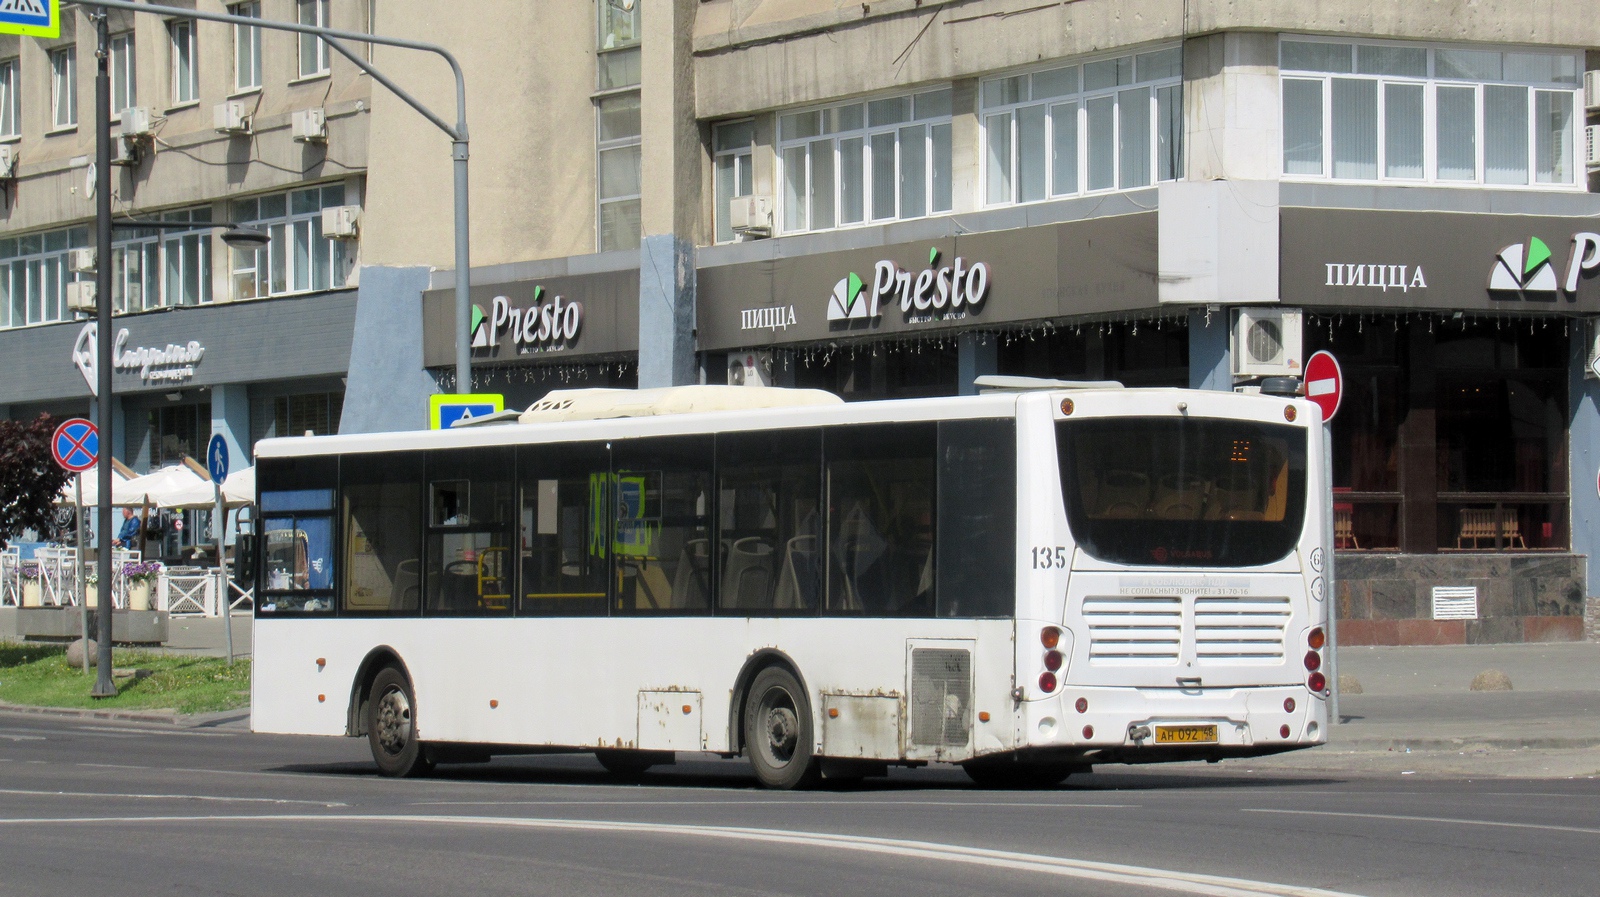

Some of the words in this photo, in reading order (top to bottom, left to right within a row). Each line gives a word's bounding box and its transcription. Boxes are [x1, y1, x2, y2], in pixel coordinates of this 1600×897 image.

[1325, 263, 1427, 293] ПИЦЦА
[740, 304, 797, 332] ПИЦЦА
[1031, 546, 1066, 570] 135
[1119, 587, 1129, 595] НЕ
[1217, 587, 1249, 595] 31-70-16
[1178, 728, 1198, 741] 092
[1203, 727, 1214, 737] 48
